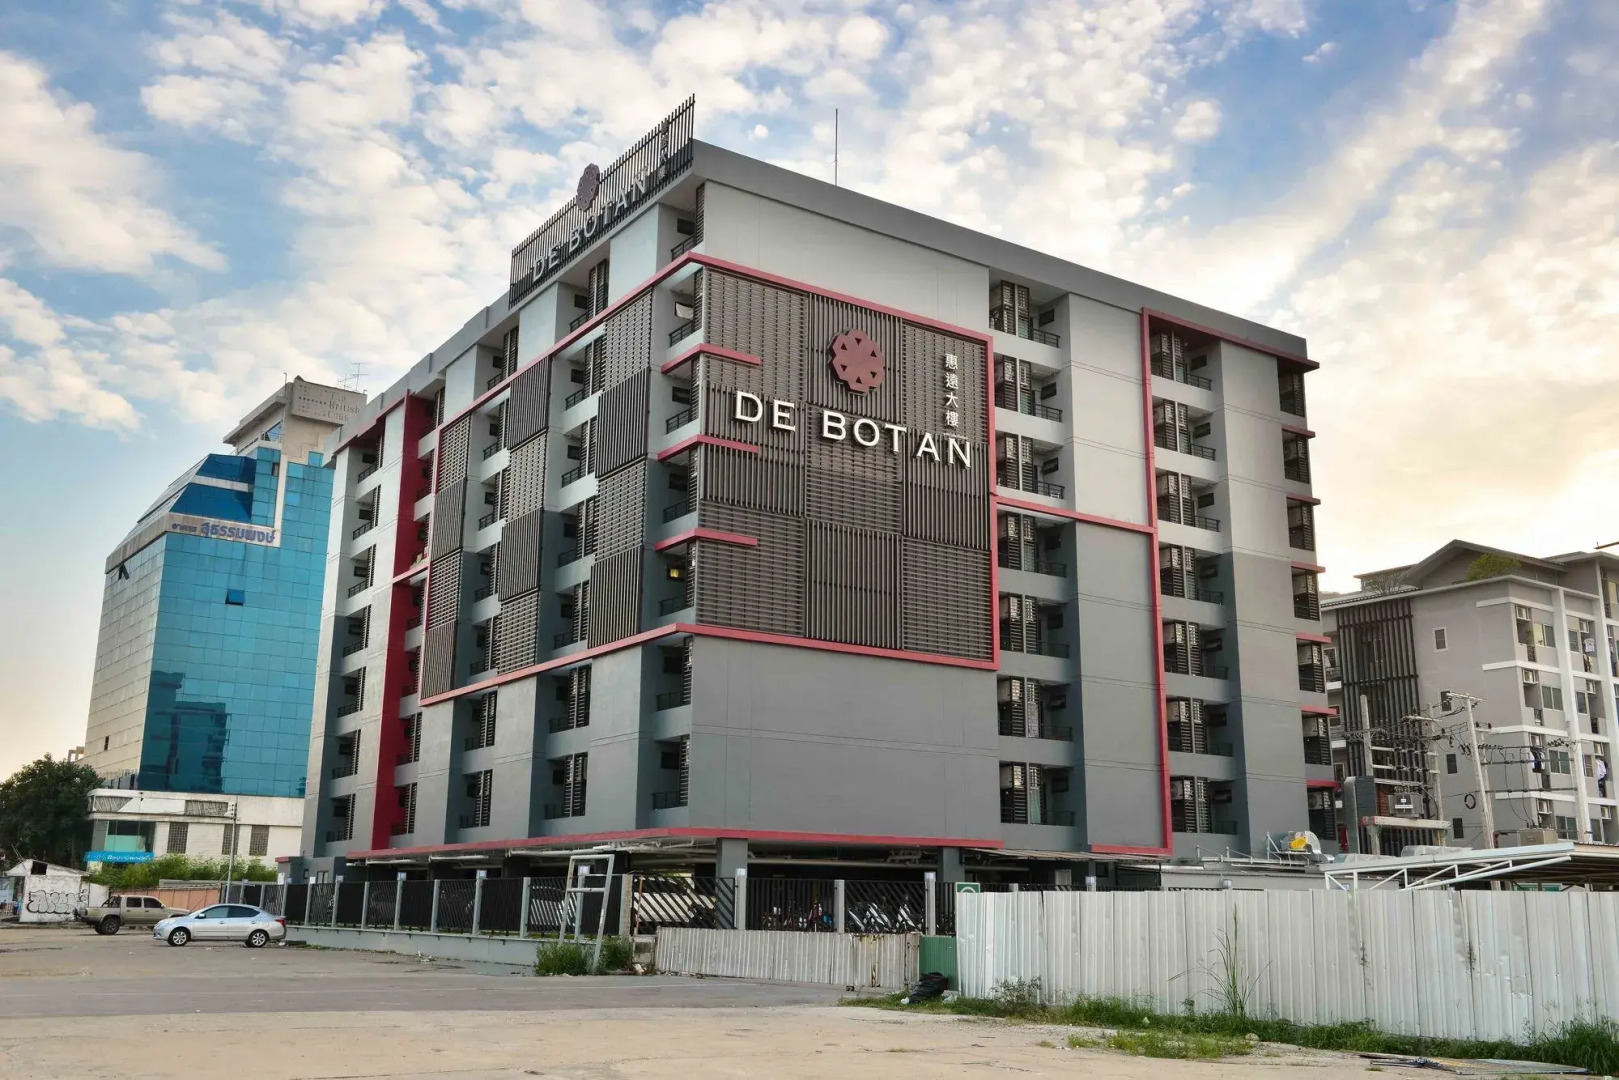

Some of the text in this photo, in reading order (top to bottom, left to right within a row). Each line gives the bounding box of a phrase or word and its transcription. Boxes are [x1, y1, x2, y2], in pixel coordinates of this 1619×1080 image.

[533, 166, 649, 282] DE BOTAN
[329, 400, 360, 415] British
[735, 390, 970, 468] DE BOTAN
